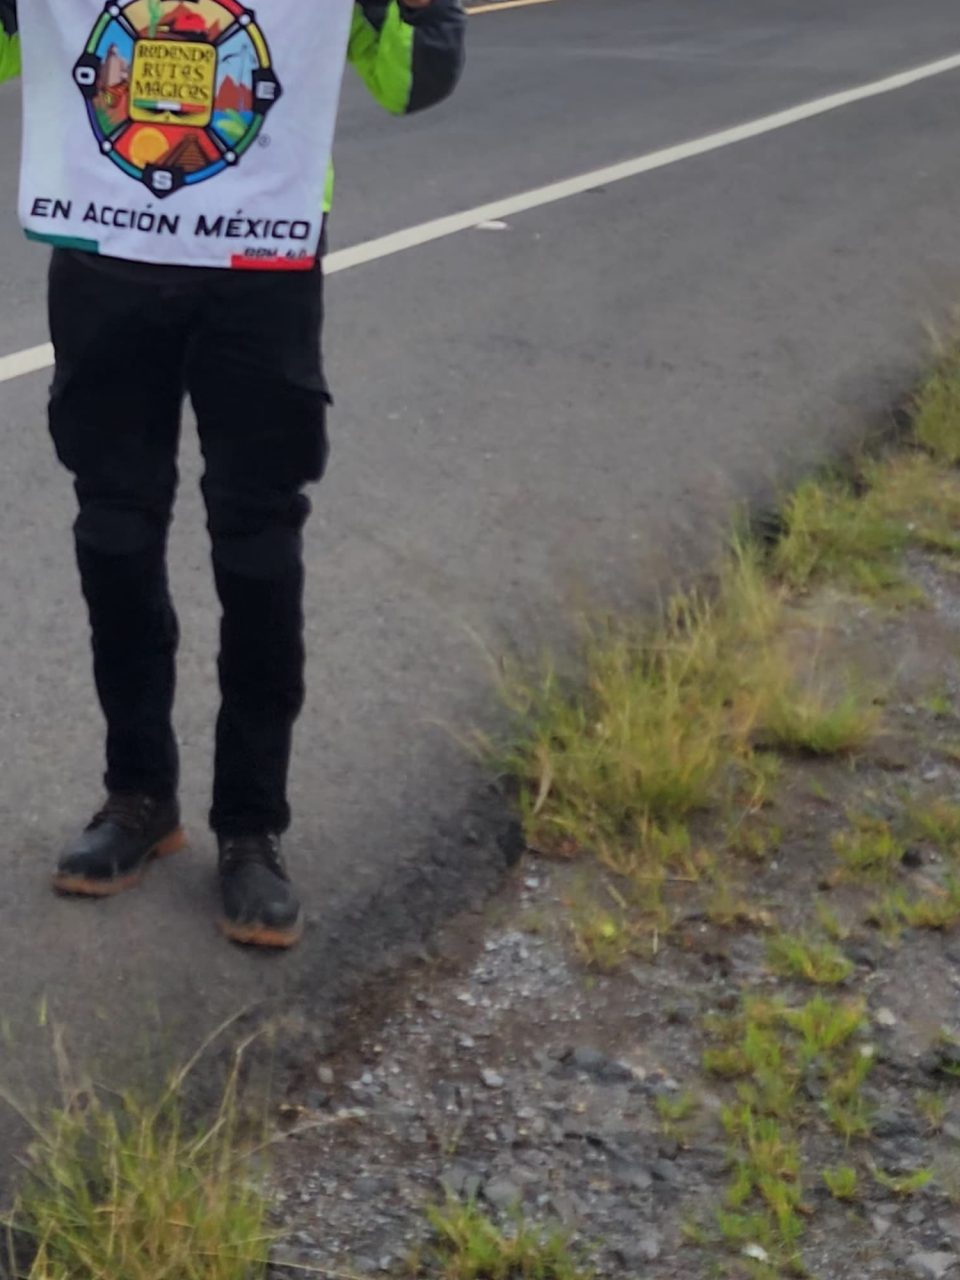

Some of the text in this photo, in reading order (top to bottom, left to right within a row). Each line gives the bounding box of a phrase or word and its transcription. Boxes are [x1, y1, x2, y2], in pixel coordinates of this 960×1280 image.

[75, 66, 96, 85] O
[256, 81, 277, 99] E
[151, 170, 173, 191] S
[30, 198, 312, 240] EN ACCIÓN MÉXICO
